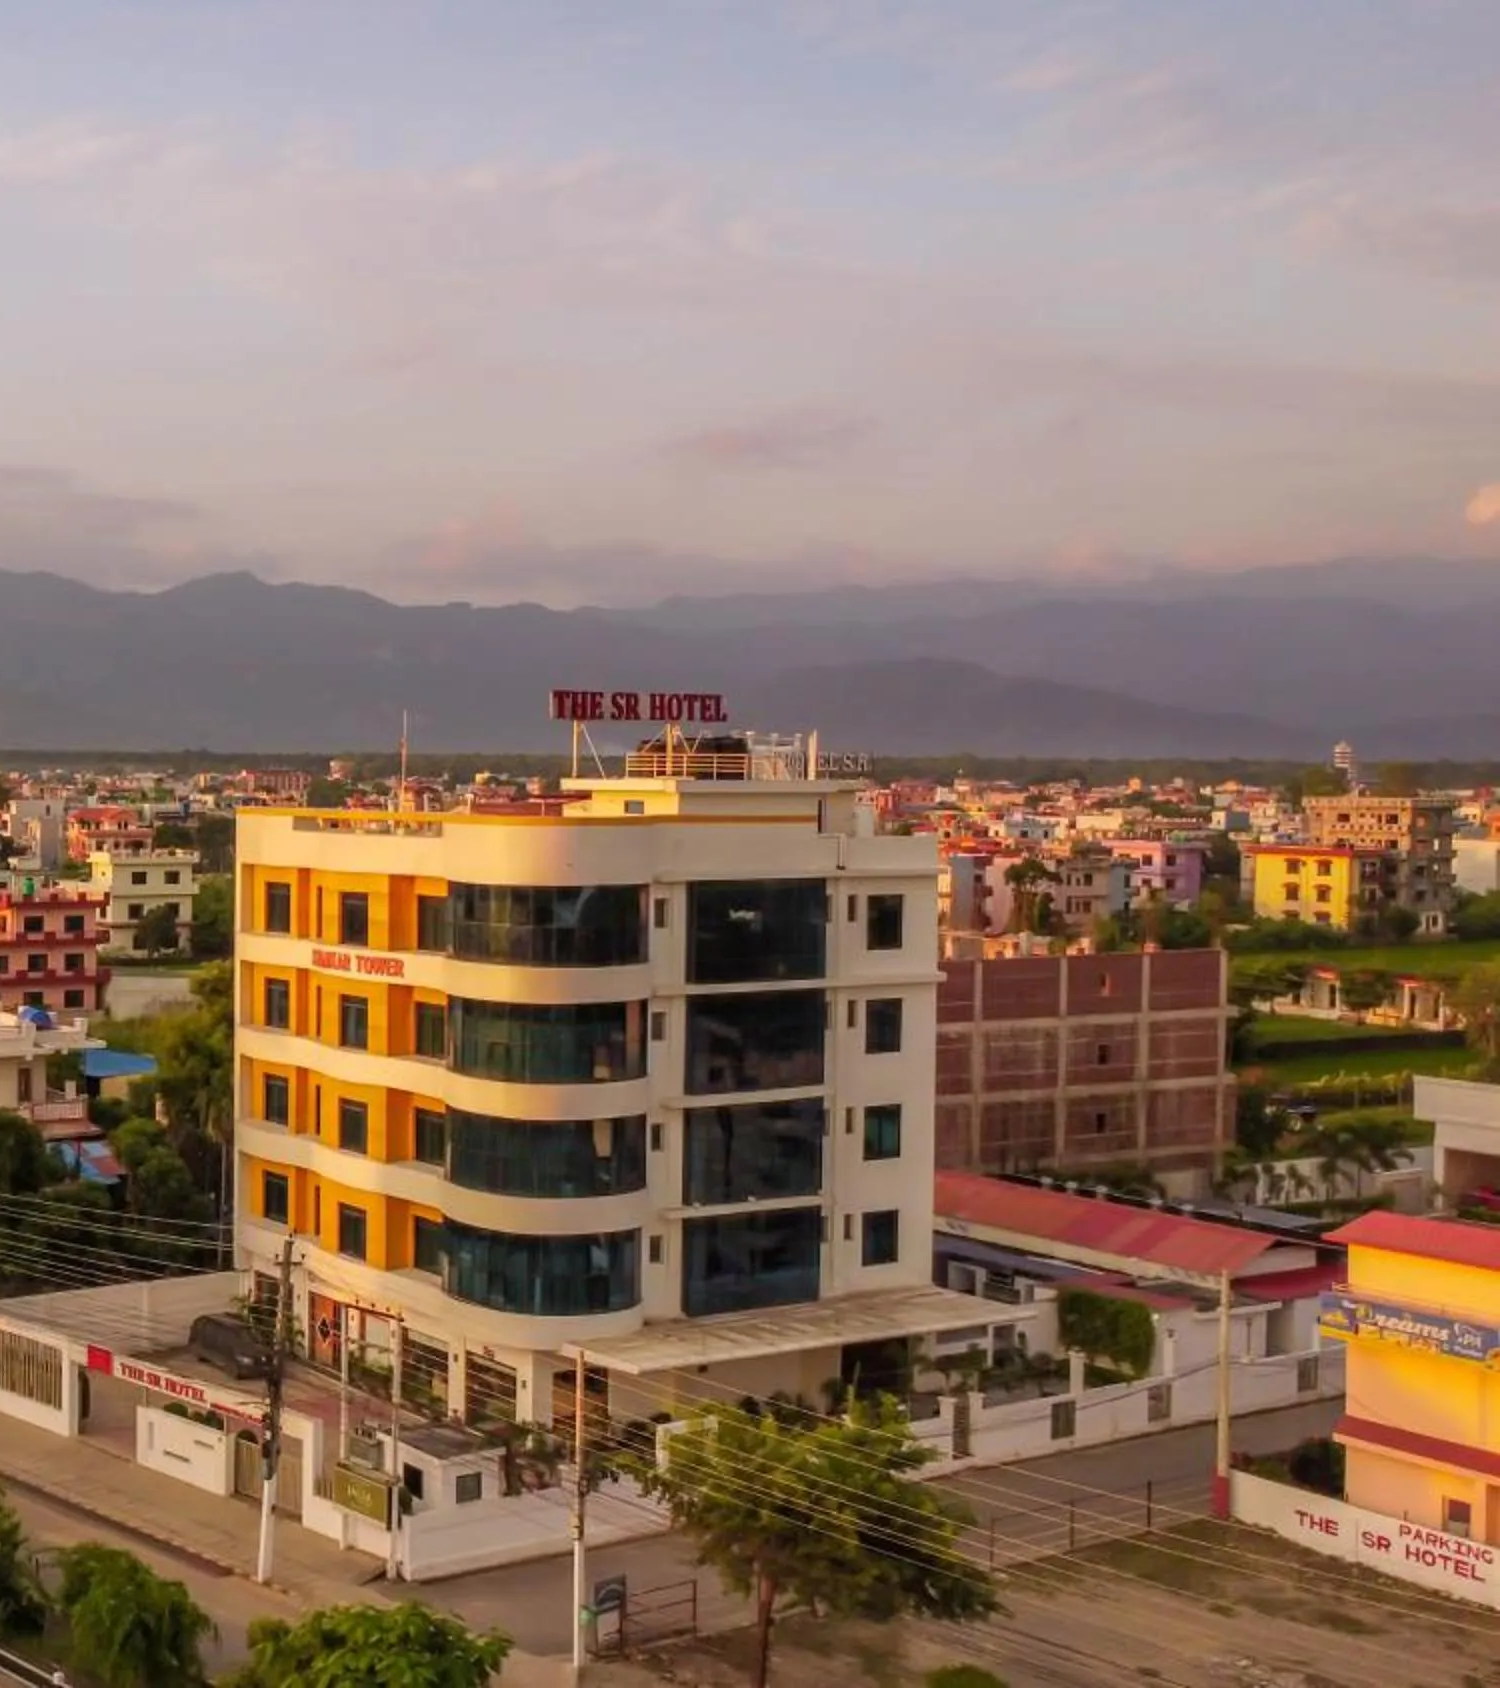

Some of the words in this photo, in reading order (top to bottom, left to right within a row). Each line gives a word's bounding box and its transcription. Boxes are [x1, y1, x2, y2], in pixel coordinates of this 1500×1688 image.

[553, 689, 604, 719] THE
[610, 691, 641, 720] SR
[649, 693, 727, 722] HOTEL
[164, 1377, 208, 1403] HOTEL
[1295, 1509, 1340, 1537] THE
[1361, 1530, 1392, 1552] SR
[1405, 1543, 1486, 1583] HOTEL
[1399, 1523, 1494, 1565] PARKING
